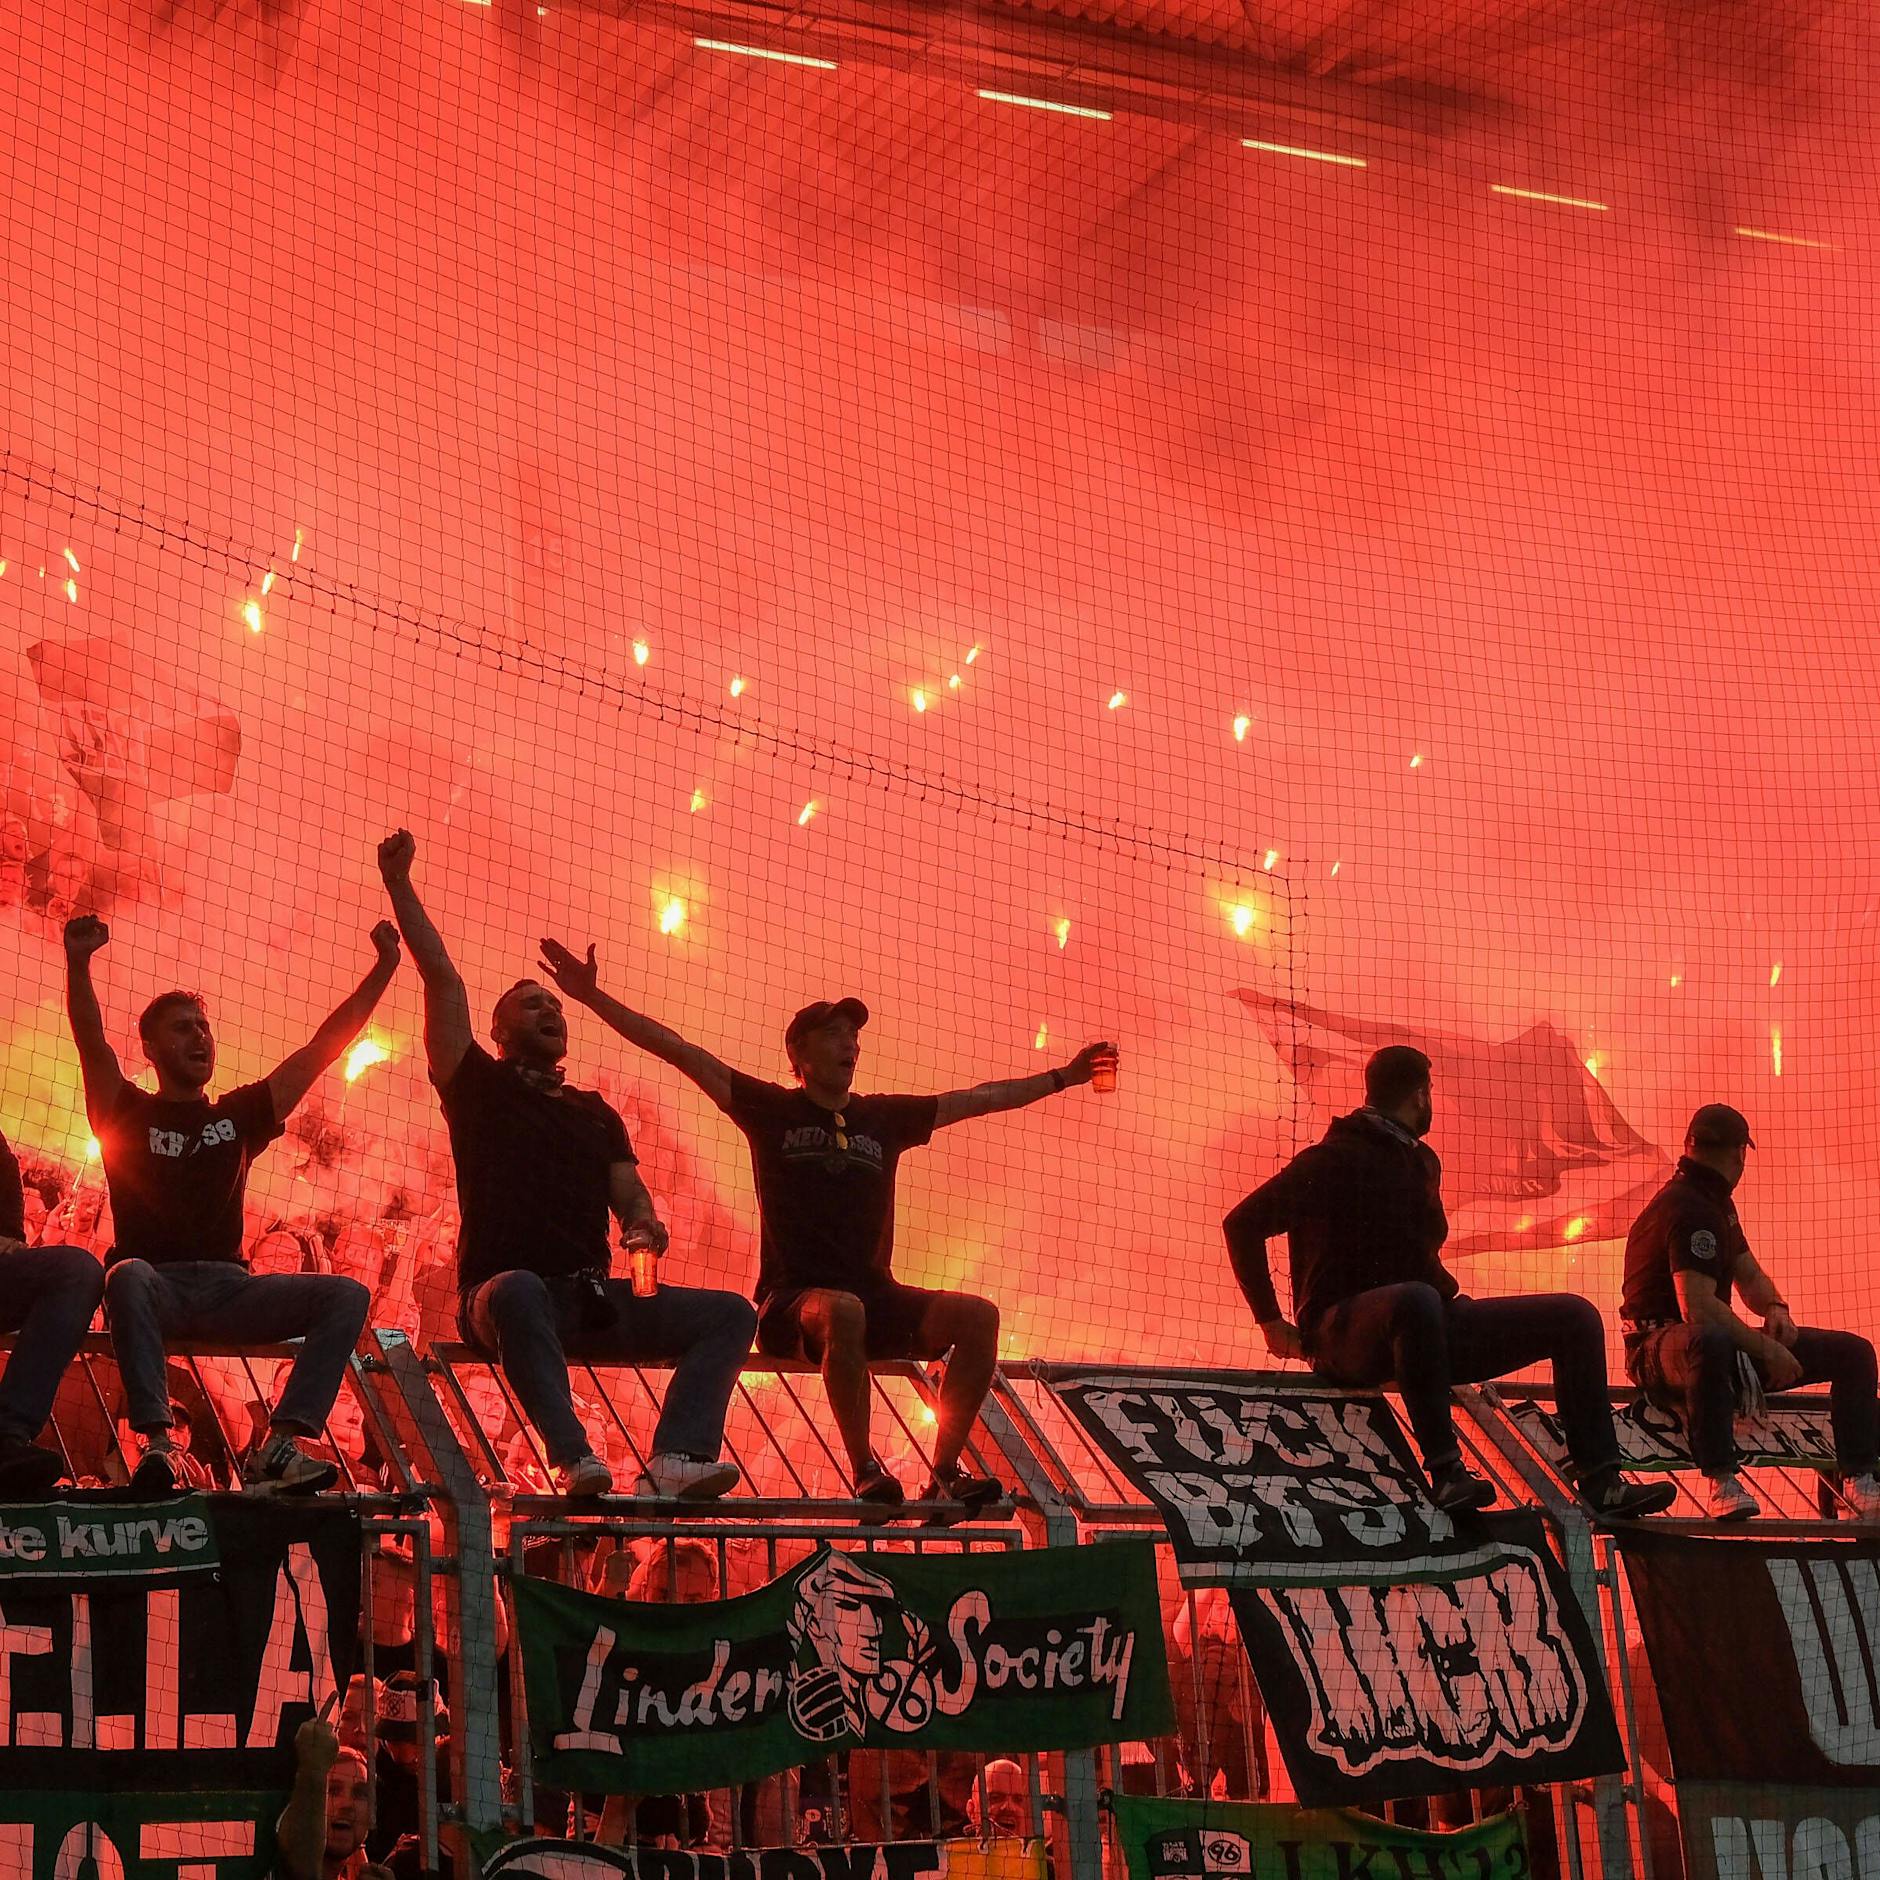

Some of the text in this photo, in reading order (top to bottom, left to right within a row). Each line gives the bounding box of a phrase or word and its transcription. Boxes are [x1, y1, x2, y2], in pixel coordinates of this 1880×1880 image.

[1083, 1391, 1406, 1473] FUCK
[56, 1515, 209, 1558] kurve
[553, 1590, 1135, 1755] Linder Society
[1209, 1841, 1242, 1864] 96
